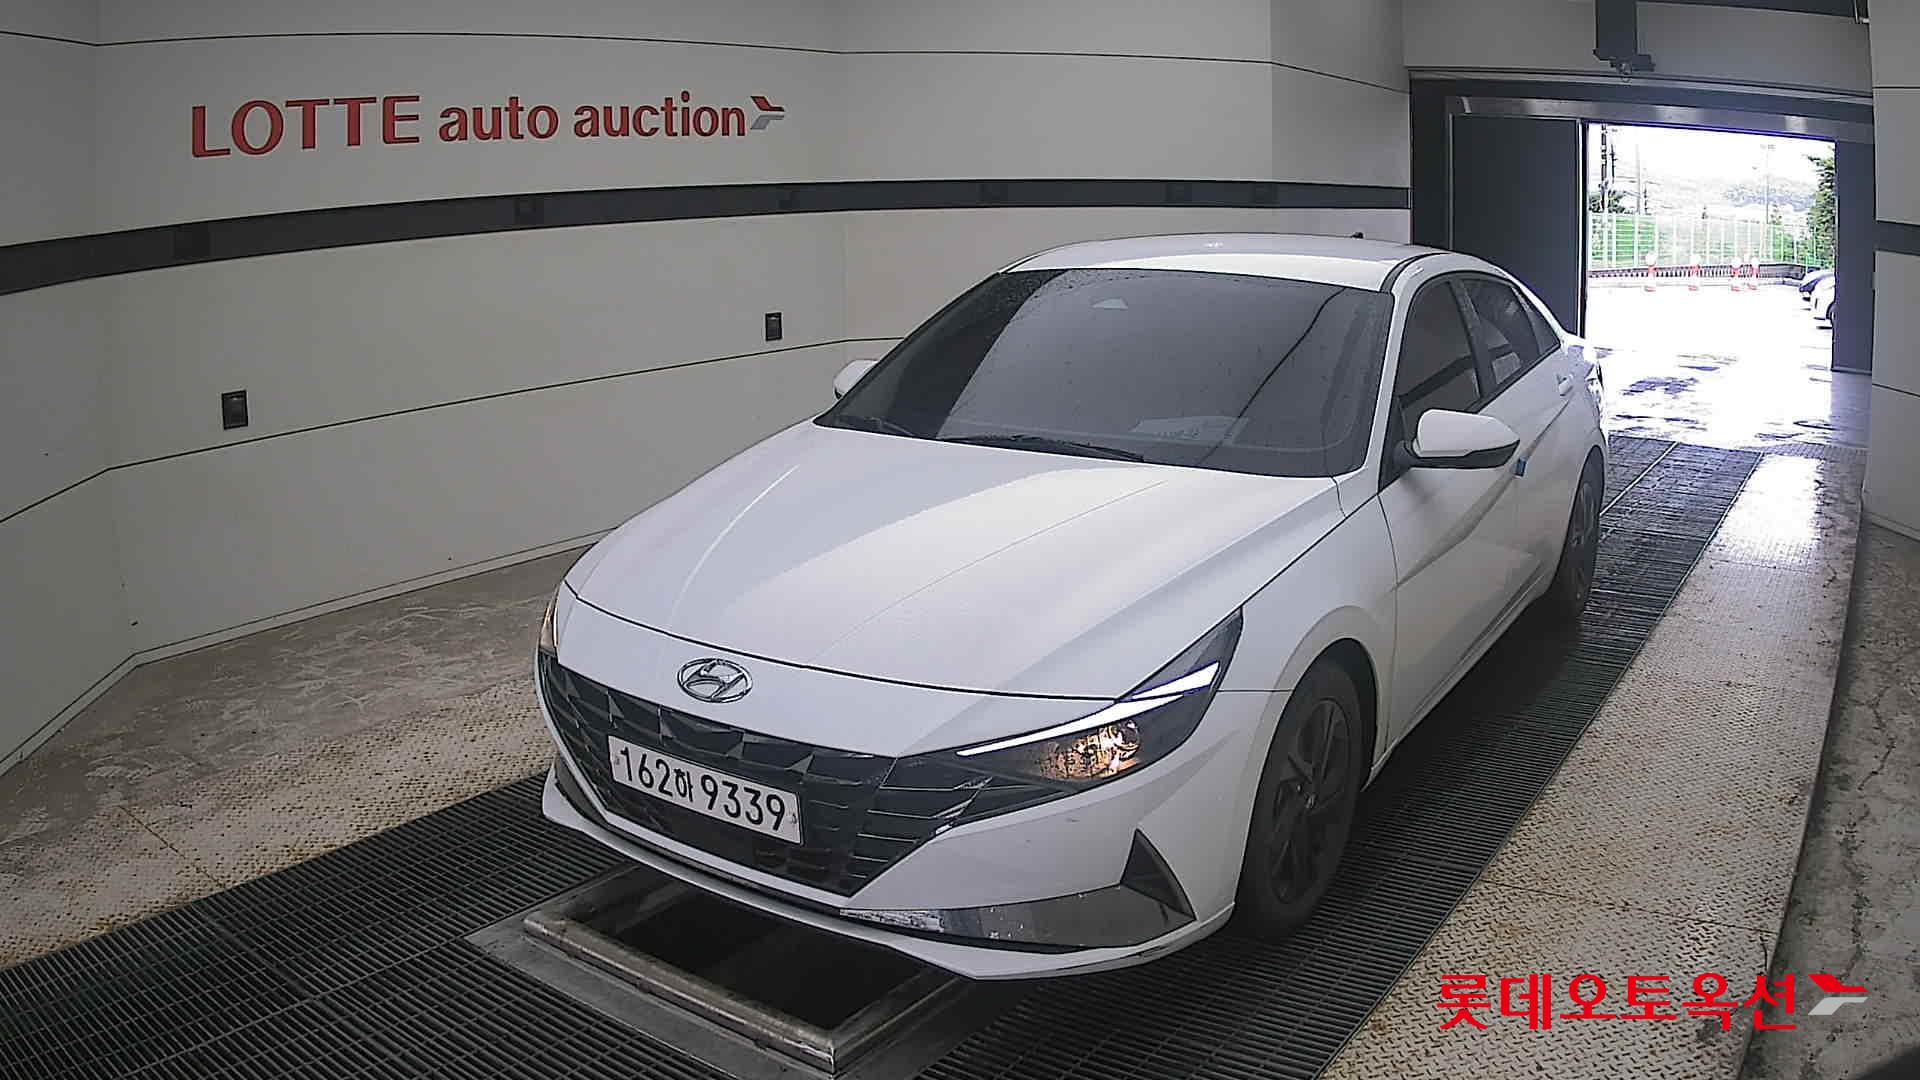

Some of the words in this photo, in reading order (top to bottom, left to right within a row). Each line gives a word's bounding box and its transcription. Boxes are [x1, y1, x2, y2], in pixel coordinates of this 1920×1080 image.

[192, 96, 420, 158] LOTTE
[438, 96, 559, 142] auto
[574, 90, 746, 138] auction
[701, 774, 785, 831] 9339
